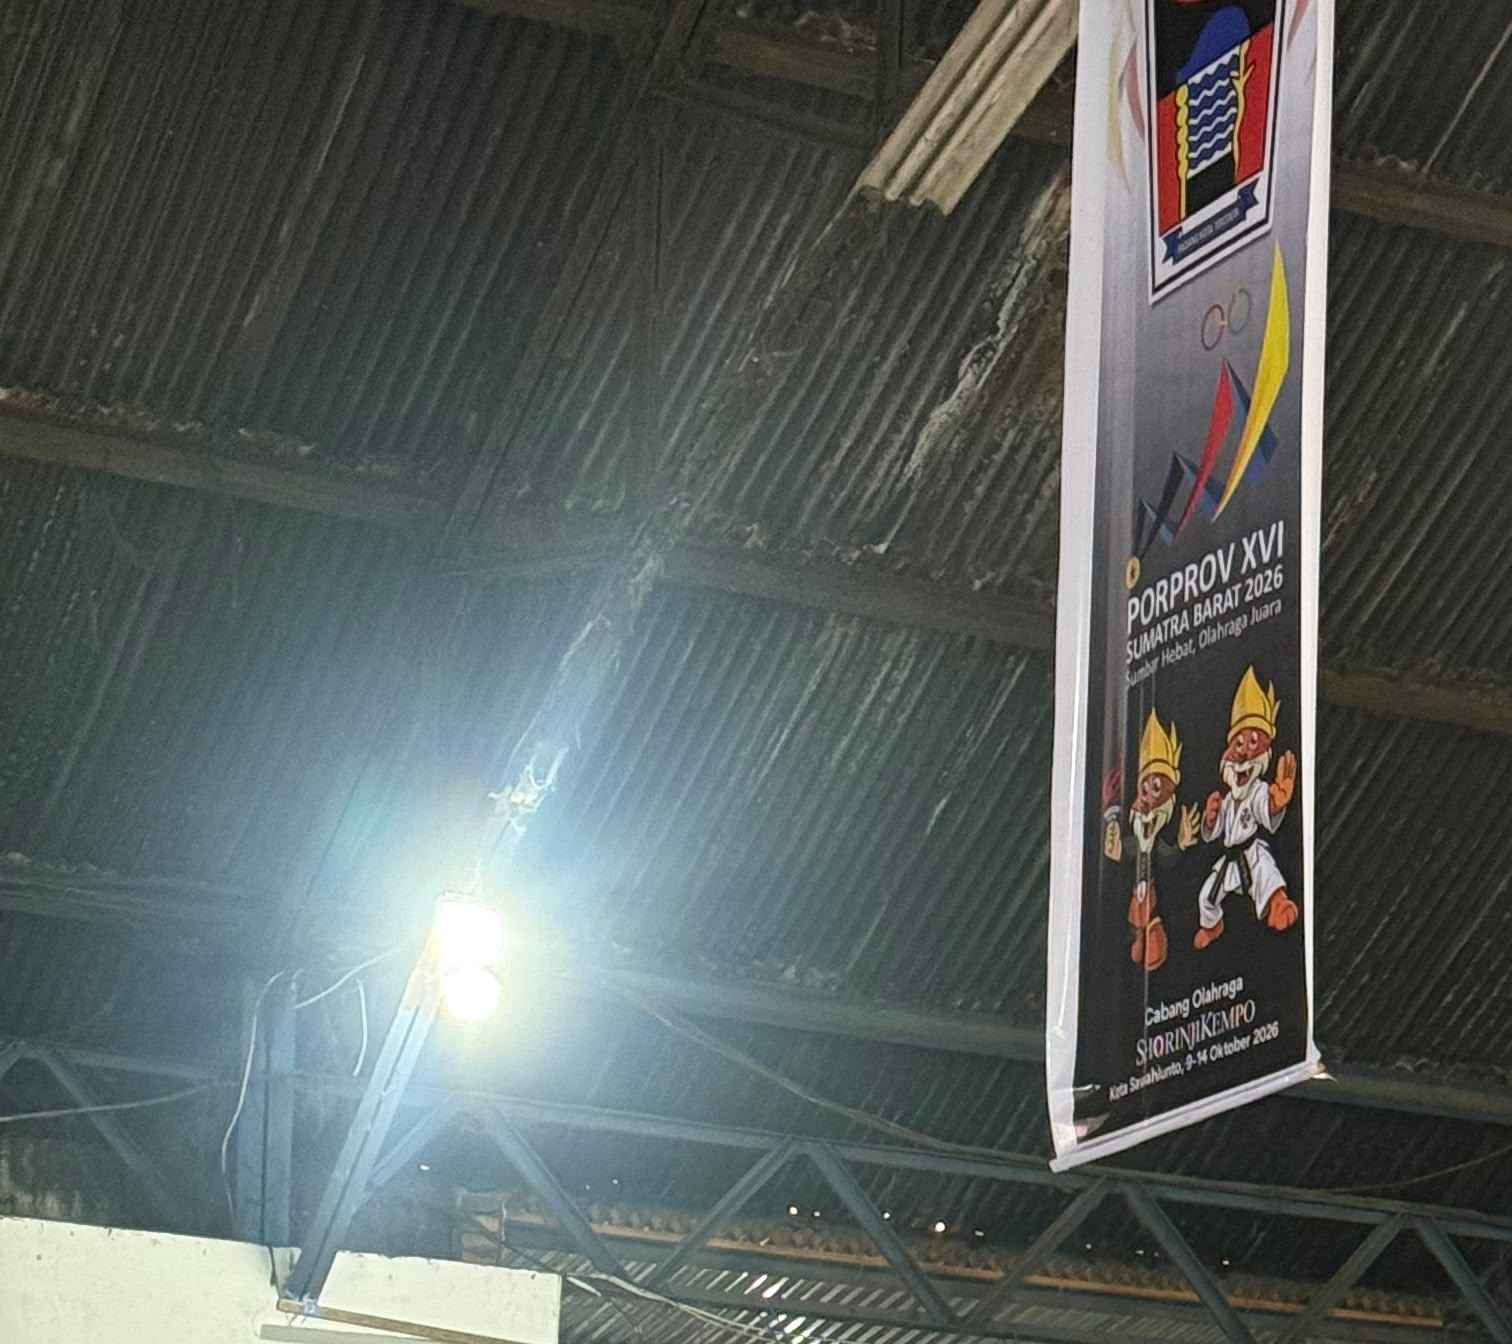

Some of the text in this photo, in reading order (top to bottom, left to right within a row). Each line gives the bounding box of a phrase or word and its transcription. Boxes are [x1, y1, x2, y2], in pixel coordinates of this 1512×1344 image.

[1127, 520, 1284, 634] PORPROV XVI
[1126, 564, 1283, 664] SUMATRA BARAT 2026
[1199, 613, 1248, 649] Olahraga
[1250, 598, 1282, 626] Juara
[1145, 976, 1243, 1026] Cabang Olahraga
[1252, 1021, 1280, 1045] 2026
